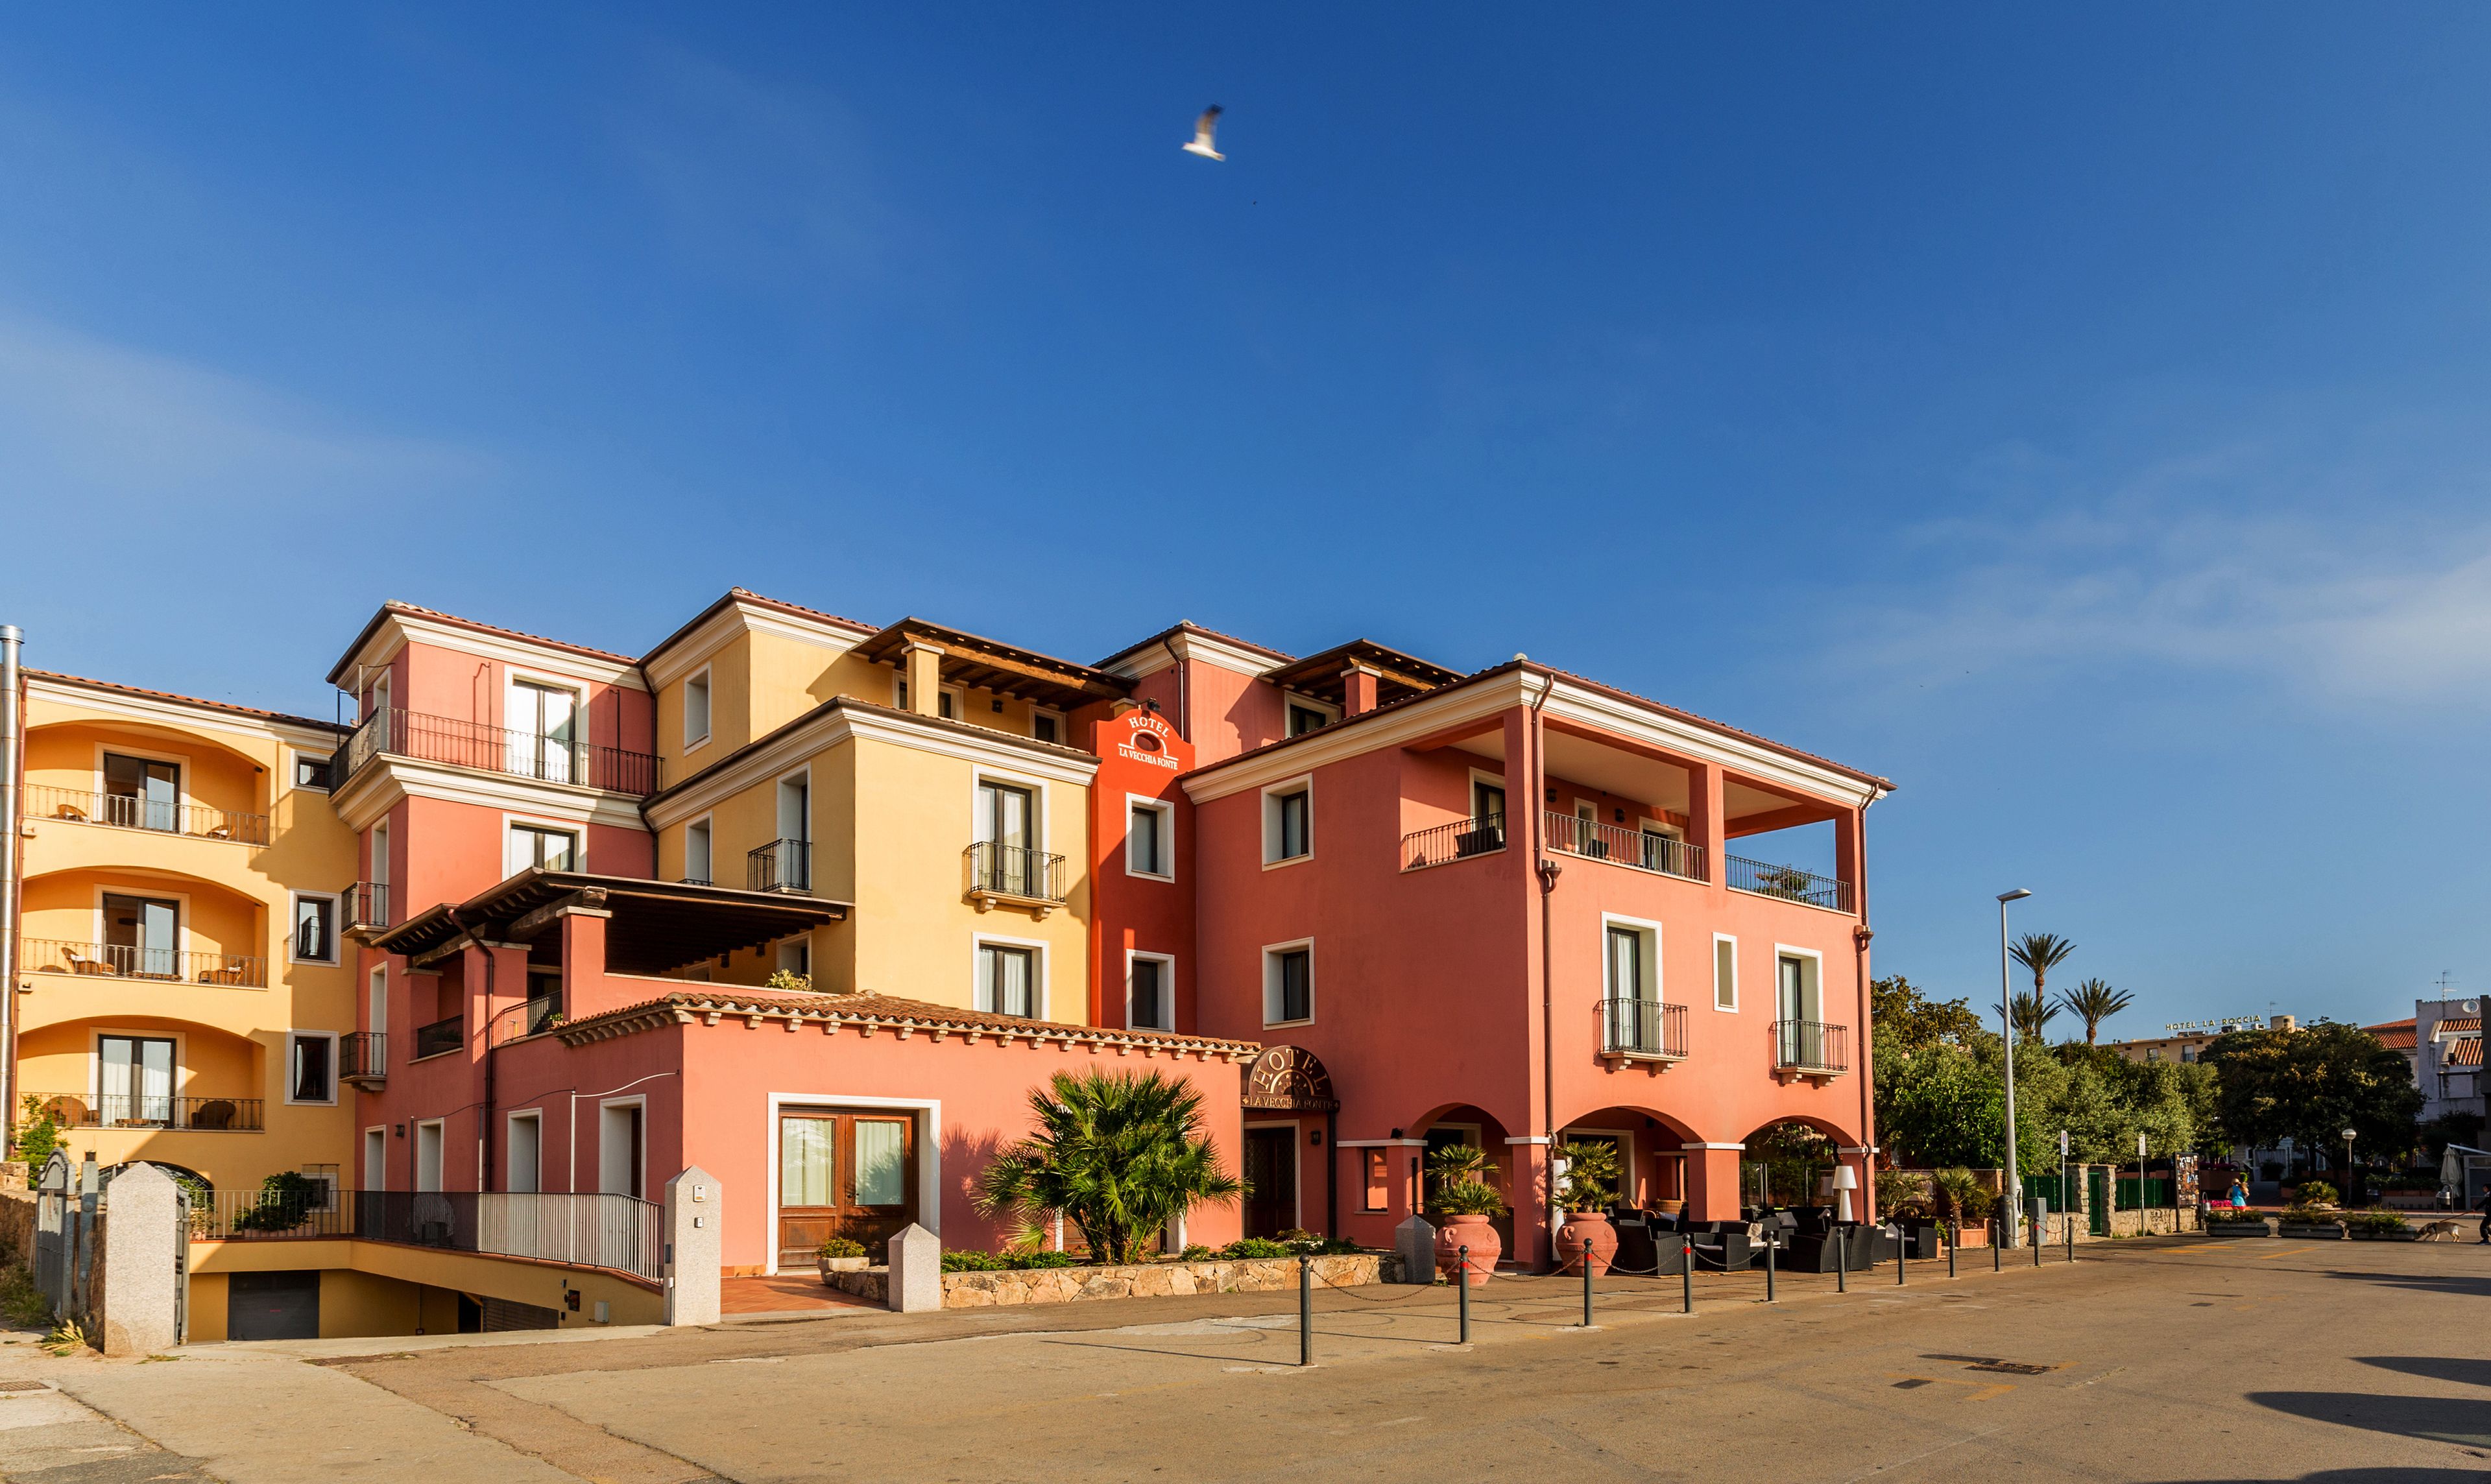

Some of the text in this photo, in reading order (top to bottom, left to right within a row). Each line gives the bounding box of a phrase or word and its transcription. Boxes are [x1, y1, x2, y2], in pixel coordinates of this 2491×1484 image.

[1128, 717, 1169, 737] HOTEL
[1119, 748, 1178, 771] LA VECCHIA FONTE
[2165, 1021, 2196, 1031] HOTEL
[2222, 1014, 2261, 1025] ROCCIA
[1253, 1048, 1329, 1090] HOTEL
[1249, 1097, 1333, 1110] LA VECCHIA FONTE
